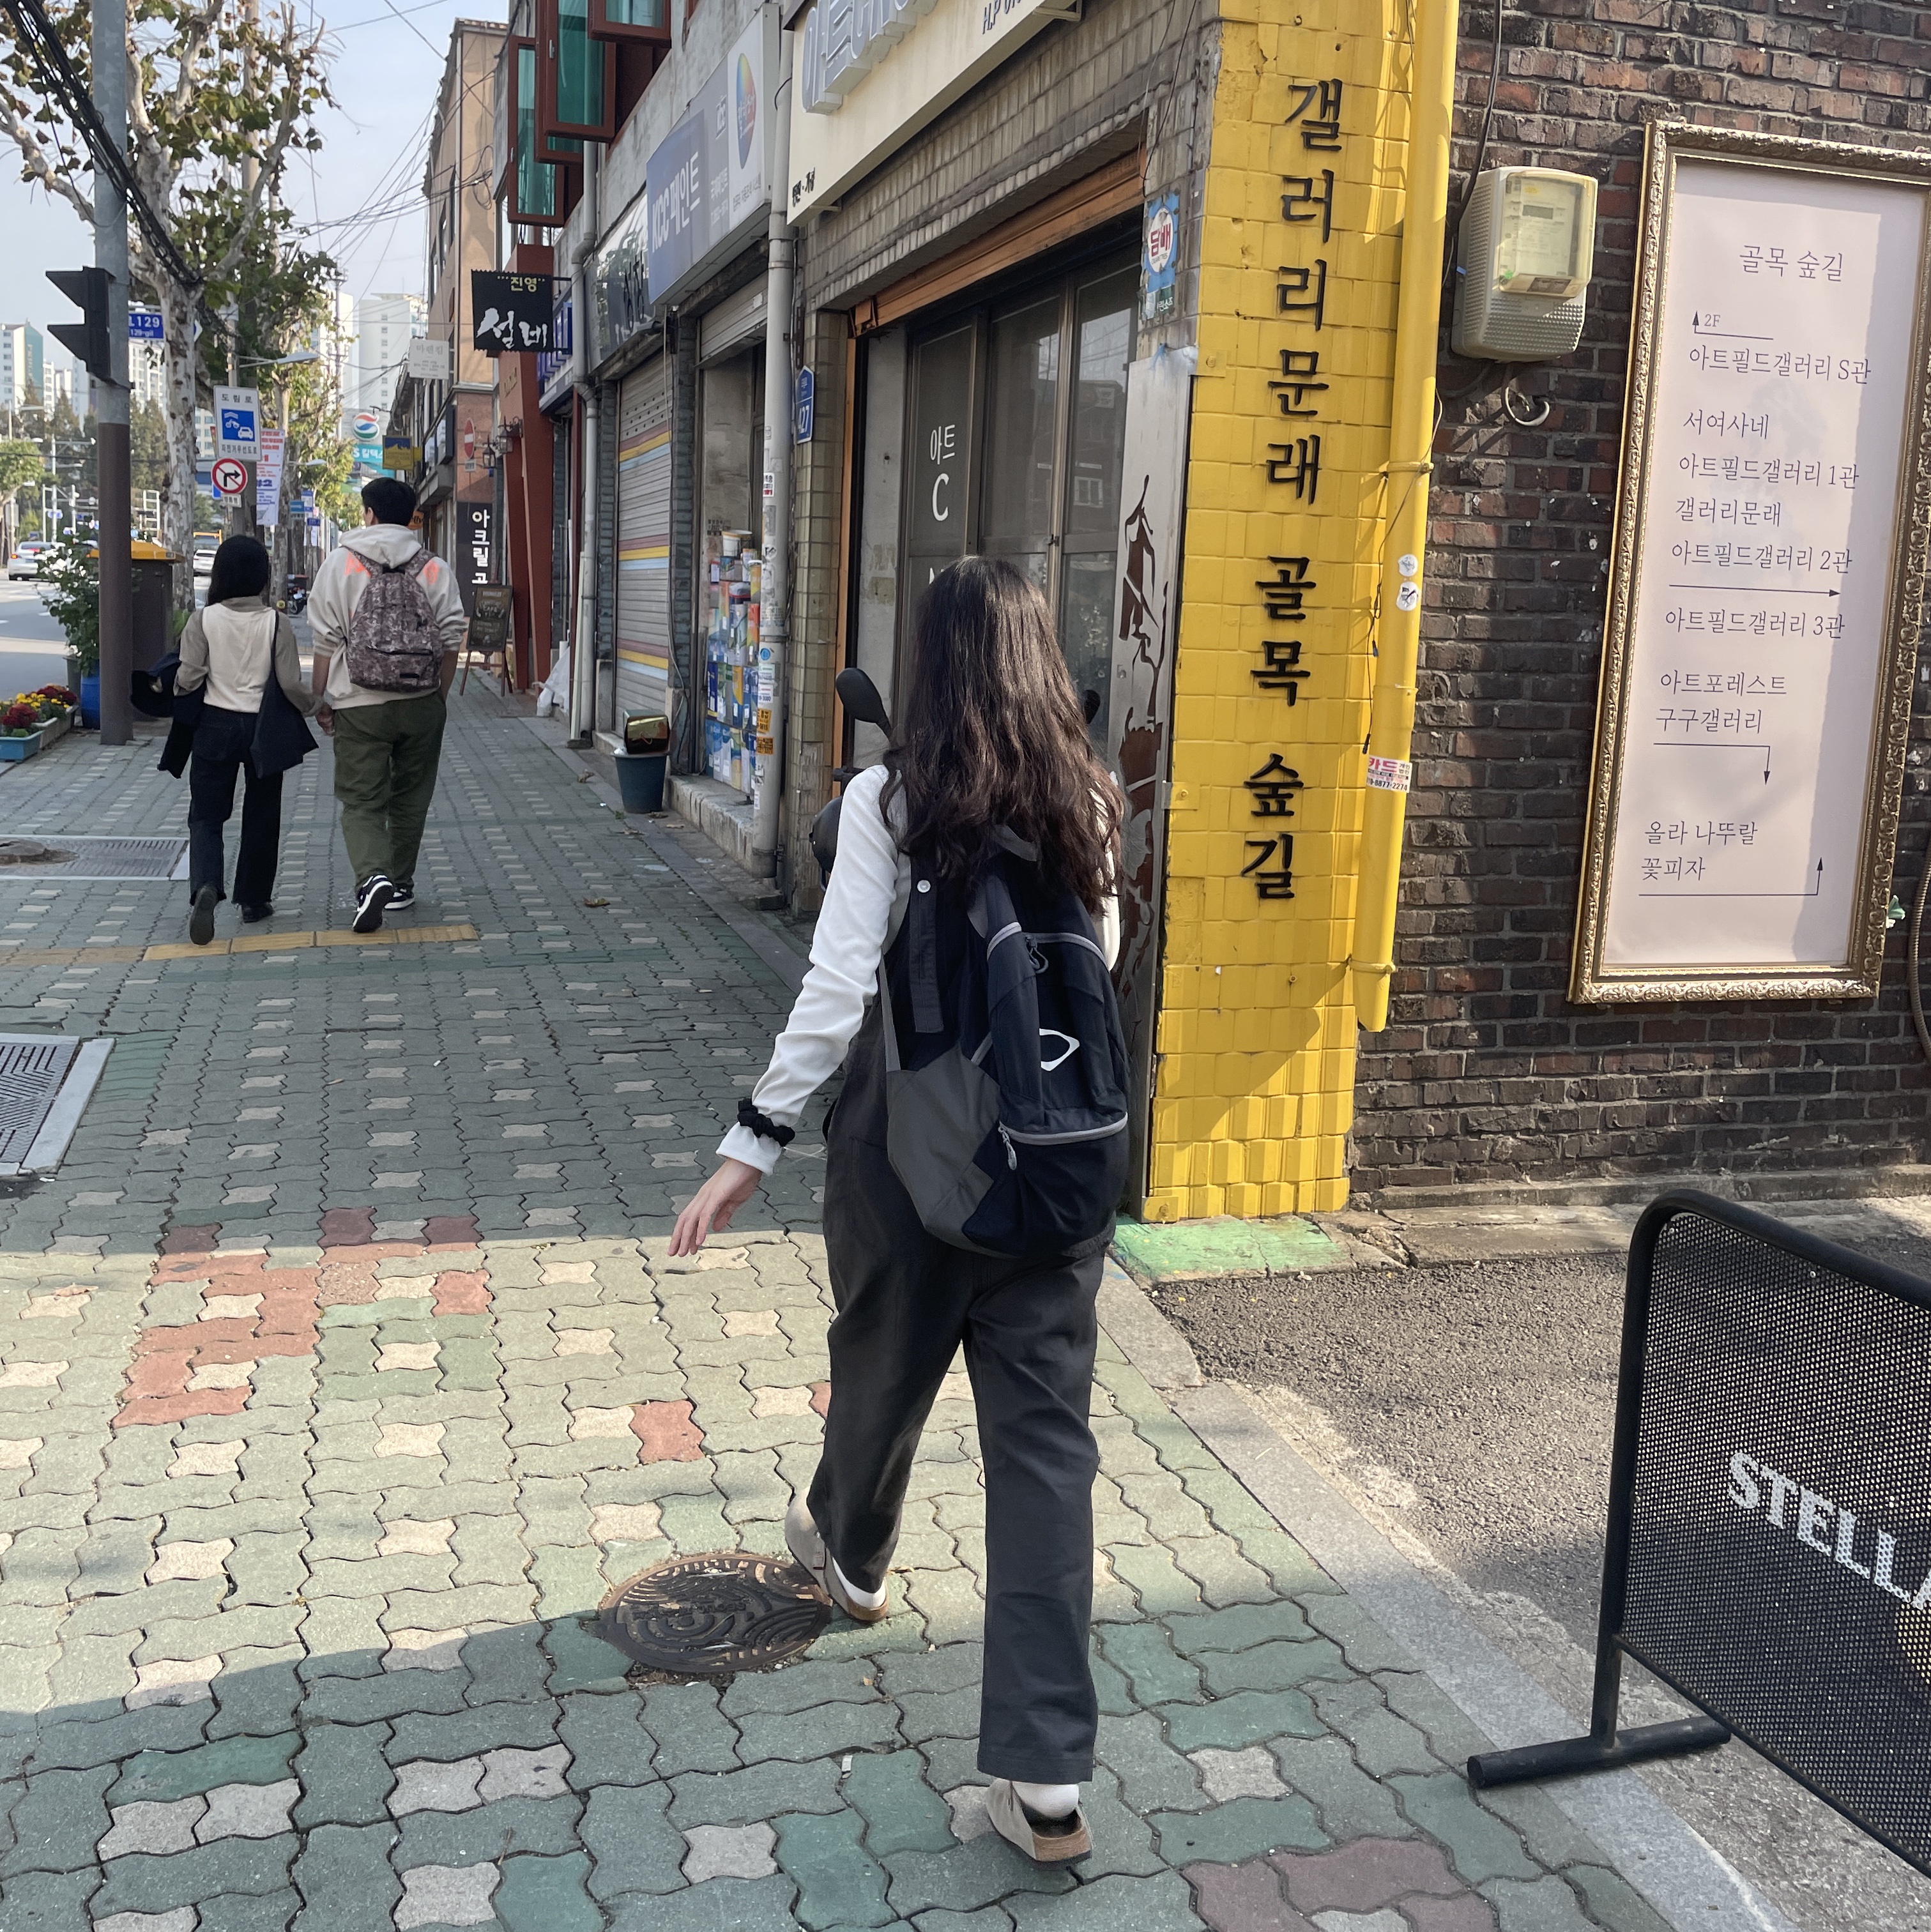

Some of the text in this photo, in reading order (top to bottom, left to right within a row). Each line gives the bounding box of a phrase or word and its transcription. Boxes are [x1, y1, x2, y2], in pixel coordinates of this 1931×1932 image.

[1150, 223, 1172, 257] 담배
[1739, 245, 1843, 282] 골목 숲길
[511, 276, 538, 293] 진영
[1704, 314, 1721, 327] 2F
[1690, 344, 1872, 384] 아트필드갤러리 S관
[221, 393, 252, 404] 도림로
[1683, 409, 1769, 439] 서여사네
[930, 424, 956, 465] 아트
[1679, 452, 1859, 489] 아트필드갤러리 1관
[932, 473, 949, 522] C
[1241, 77, 1343, 899] 갤러리문래 골목 숲길
[1675, 497, 1781, 528] 갤러리문래
[1672, 540, 1853, 574] 아트필드갤러리 2관
[1665, 607, 1845, 639] 아트필드갤러리 3관
[1660, 669, 1787, 697] 아트포레스트
[1656, 708, 1762, 734] 구구갤러리
[1369, 757, 1398, 773] 카드
[1645, 819, 1758, 846] 올라 나뚜랄
[1641, 856, 1706, 881] 꽃피자
